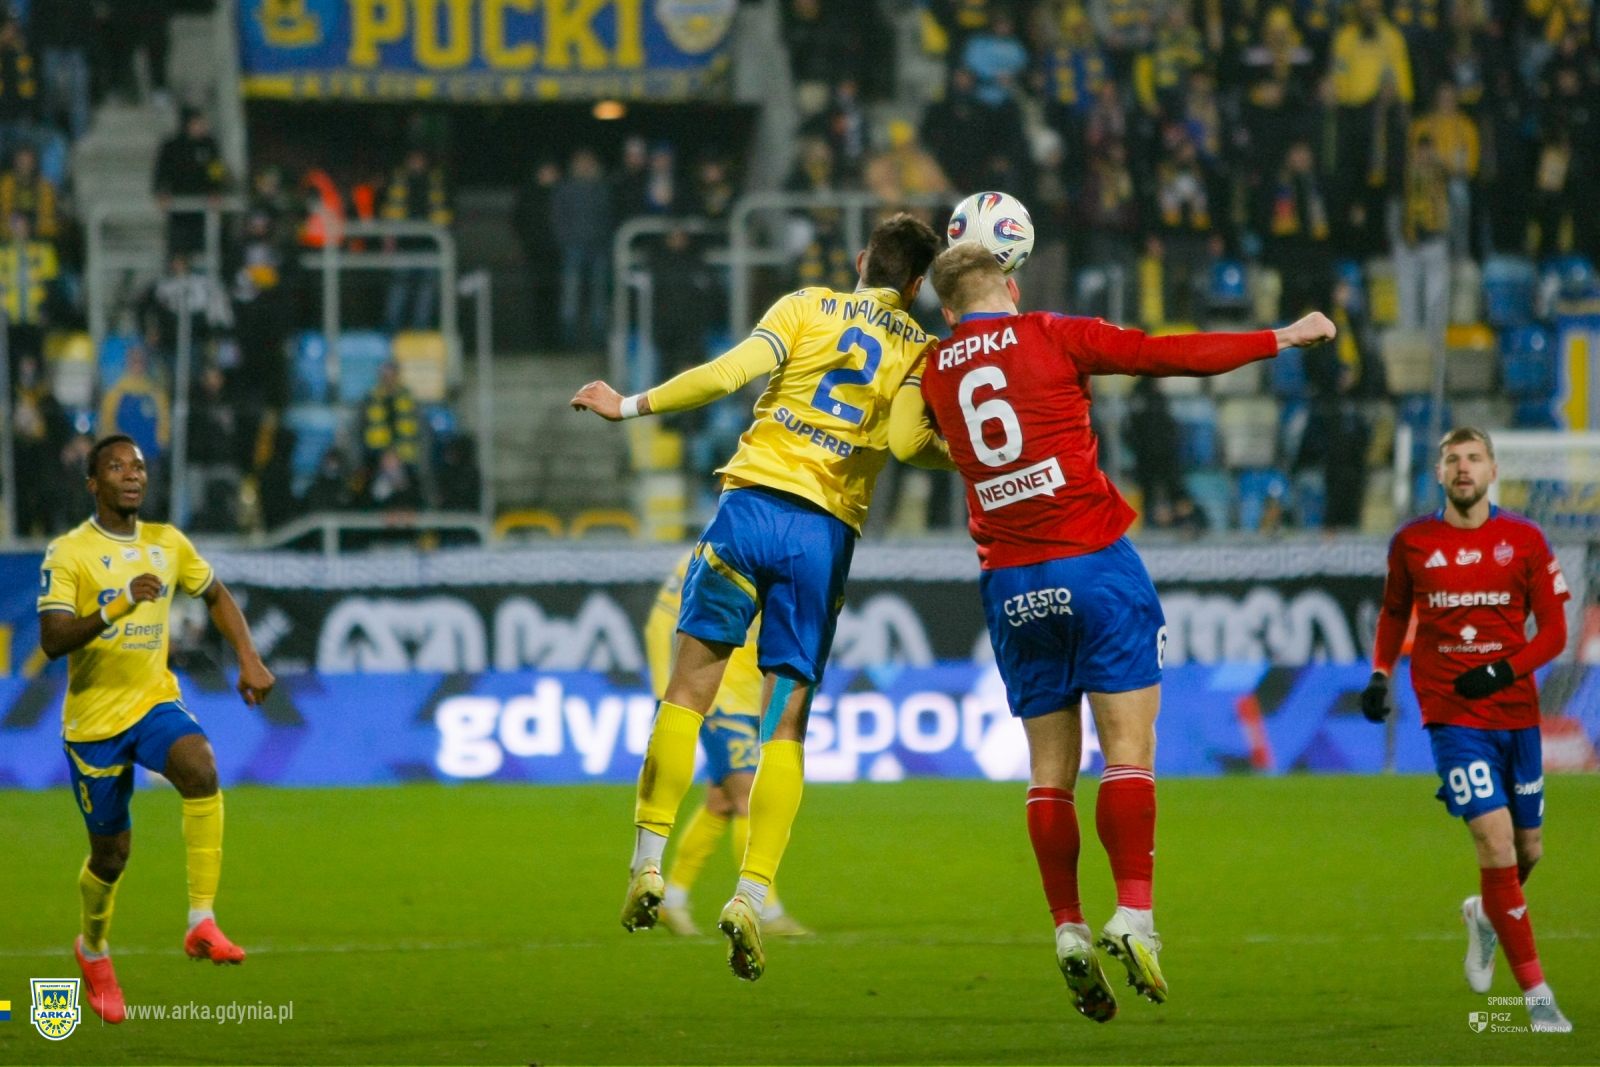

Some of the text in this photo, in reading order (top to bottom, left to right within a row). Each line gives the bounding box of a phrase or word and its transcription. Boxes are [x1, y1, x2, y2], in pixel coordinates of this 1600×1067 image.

[348, 0, 646, 69] PUCKI
[938, 326, 1018, 371] REPKA
[811, 326, 882, 425] 2
[773, 407, 862, 459] SUPERB
[958, 365, 1023, 468] 6
[978, 465, 1054, 505] NEONET
[1428, 590, 1511, 608] Hisense
[1449, 759, 1495, 806] 99
